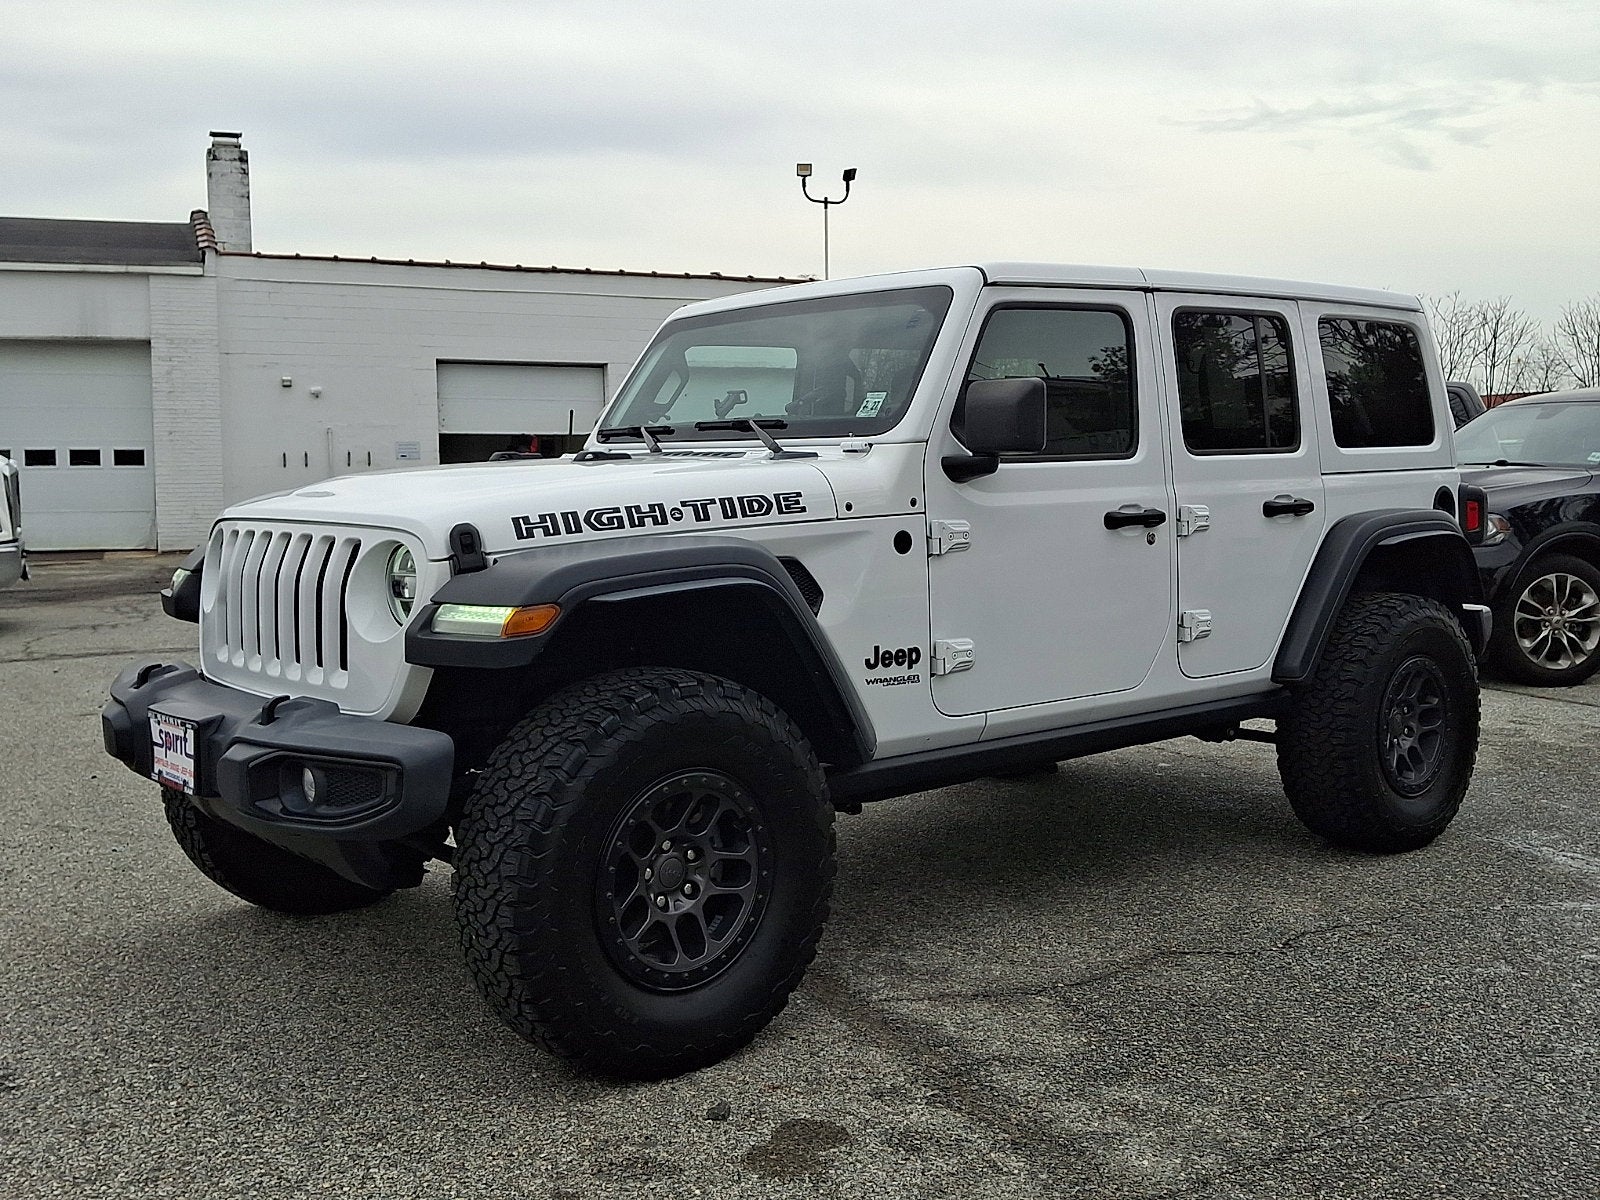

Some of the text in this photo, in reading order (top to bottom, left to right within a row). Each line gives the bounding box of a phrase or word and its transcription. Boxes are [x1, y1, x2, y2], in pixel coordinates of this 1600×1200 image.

[511, 491, 807, 540] HIGH TIDE
[864, 645, 921, 670] Jeep
[865, 674, 920, 686] WRANGLER
